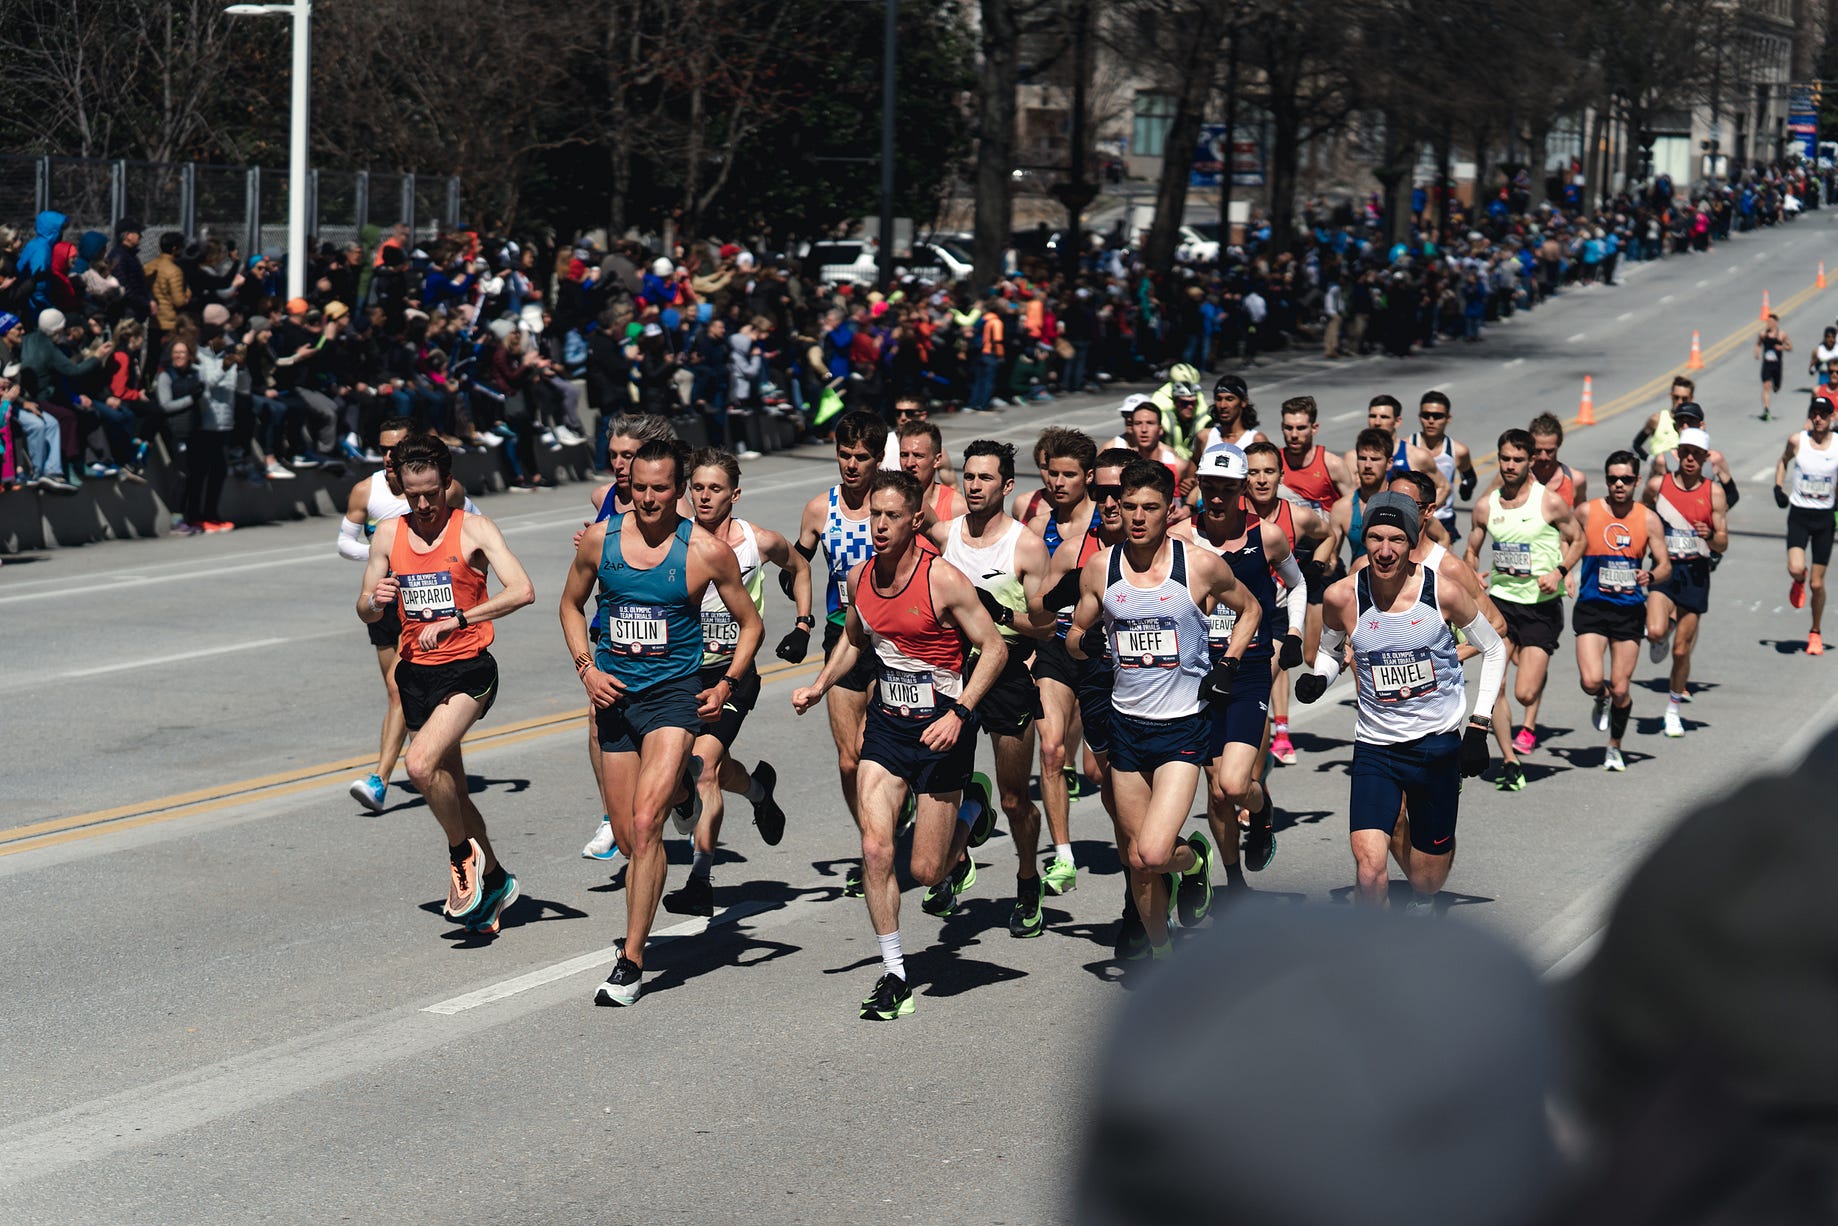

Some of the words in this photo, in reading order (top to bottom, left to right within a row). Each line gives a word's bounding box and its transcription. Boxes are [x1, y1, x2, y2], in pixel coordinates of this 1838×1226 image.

[603, 560, 625, 571] ZAP
[402, 586, 452, 605] CAPRARIO
[629, 606, 652, 614] OLYMPIC
[616, 620, 658, 640] STILIN
[1129, 632, 1162, 651] NEFF
[1392, 651, 1415, 659] OLYMPIC
[1397, 657, 1416, 665] TRIALS
[1380, 663, 1426, 686] HAVEL
[889, 683, 919, 703] KING
